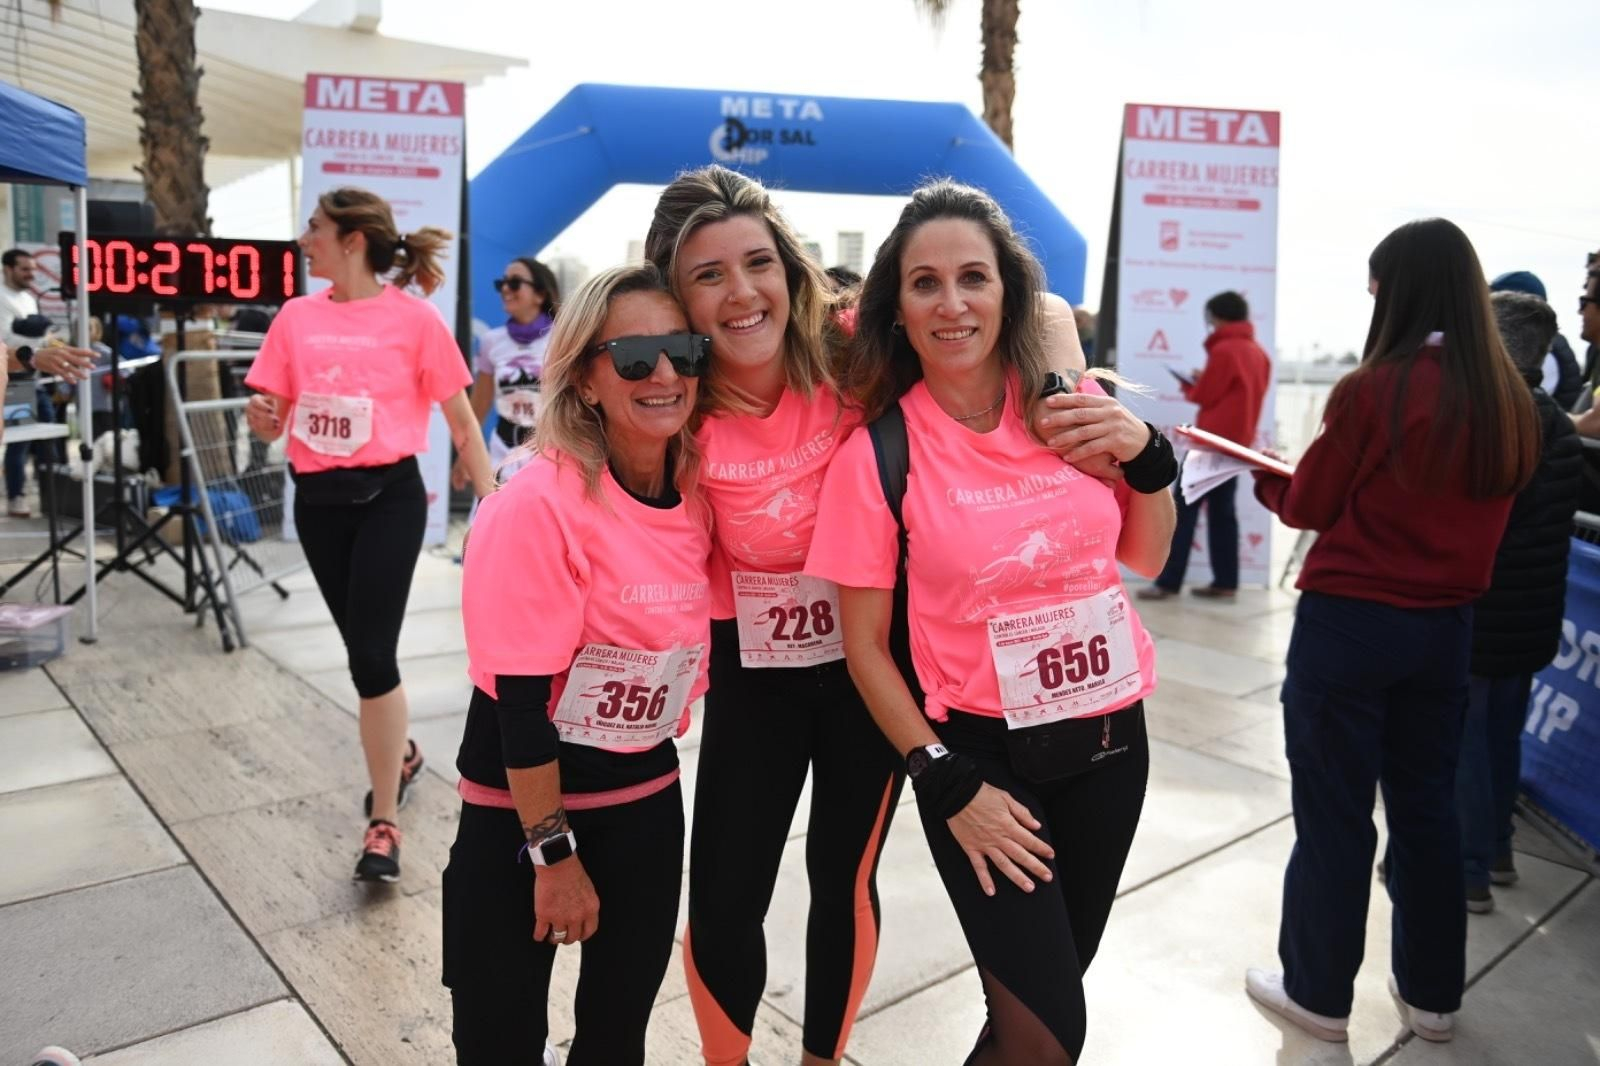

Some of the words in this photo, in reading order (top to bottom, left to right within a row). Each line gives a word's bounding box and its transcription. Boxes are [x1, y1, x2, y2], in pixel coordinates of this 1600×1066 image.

[316, 77, 451, 113] META
[721, 96, 825, 121] META
[1136, 105, 1271, 145] META
[304, 128, 380, 151] CARRERA
[384, 131, 461, 156] MUJERES
[1126, 158, 1200, 182] CARRERA
[1205, 162, 1280, 188] MUJERES
[72, 239, 294, 299] 00:27:01
[308, 413, 352, 440] 3718
[708, 457, 776, 481] CARRERA
[778, 429, 834, 472] MUJERES
[946, 484, 1018, 507] CARRERA
[621, 584, 670, 604] CARRERA
[736, 574, 767, 586] CARRERA
[767, 575, 800, 587] MUJERES
[768, 600, 835, 640] 228
[991, 615, 1034, 634] CARRERA
[1034, 606, 1076, 626] MUJERES
[619, 650, 659, 666] MUJERES
[1037, 634, 1110, 690] 656
[596, 680, 669, 722] 356
[1525, 677, 1580, 744] IP
